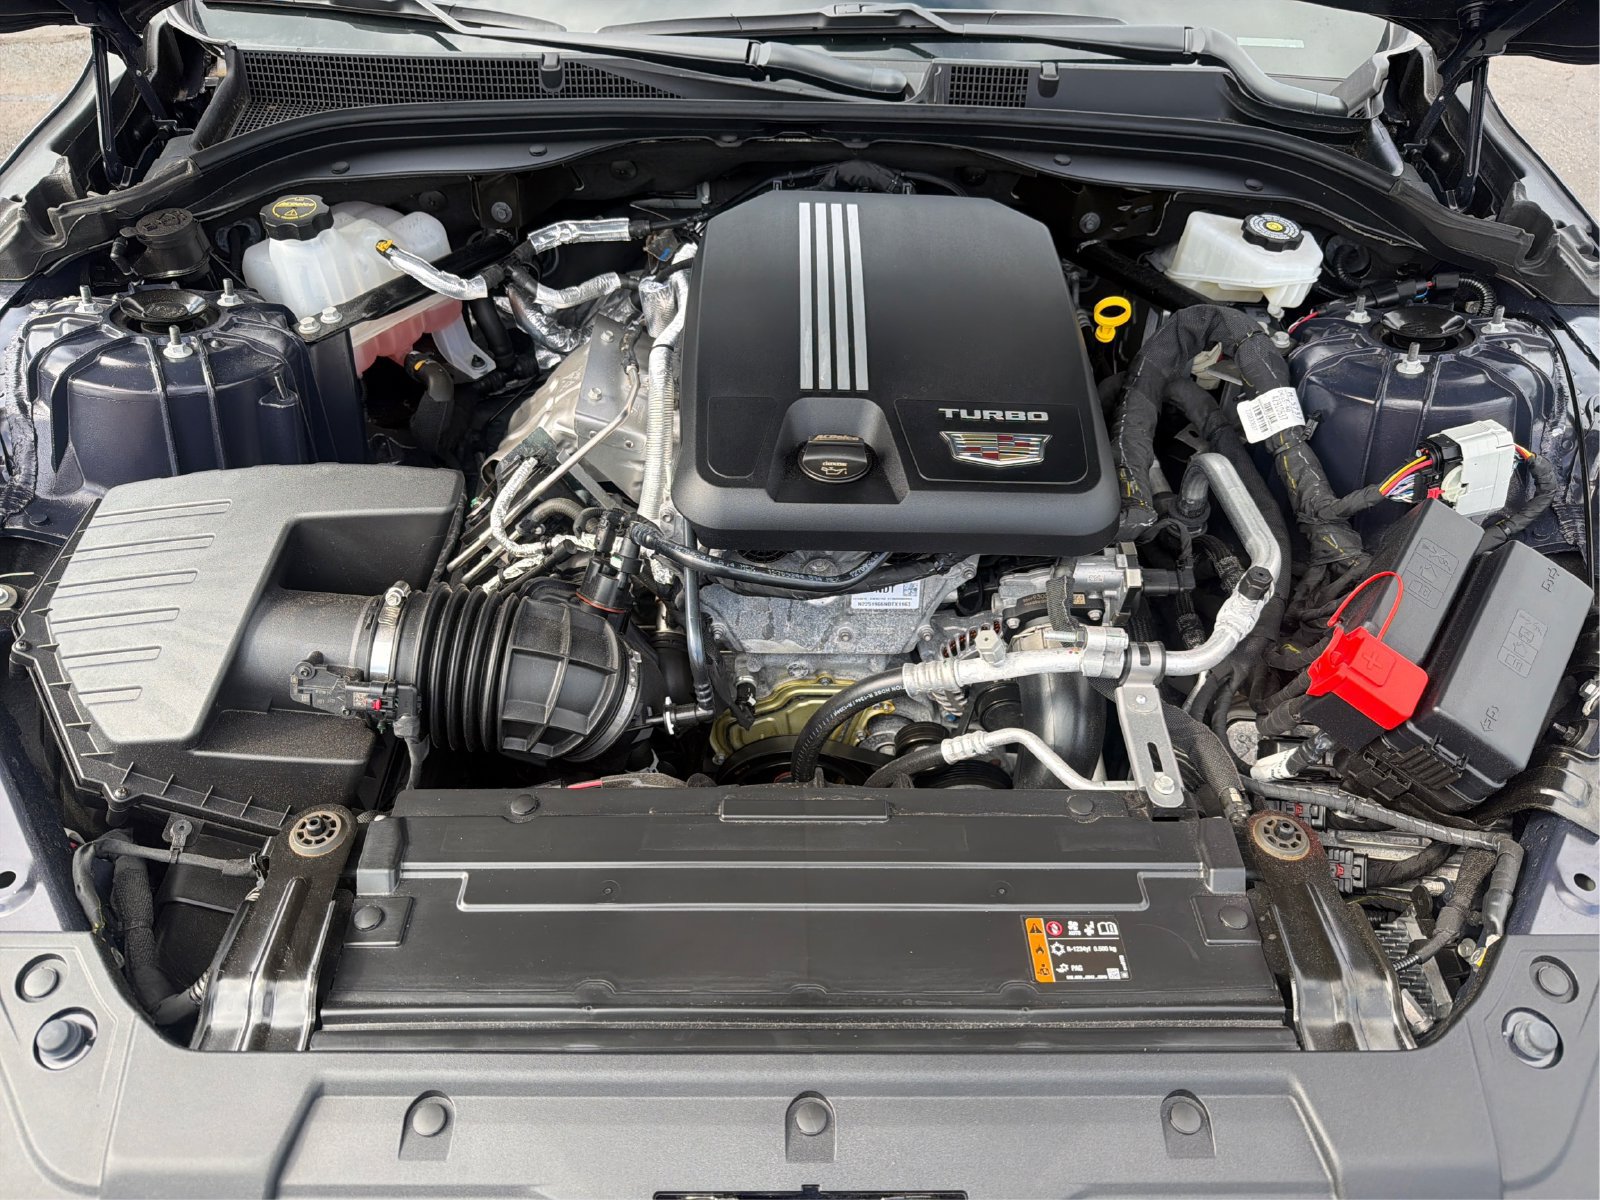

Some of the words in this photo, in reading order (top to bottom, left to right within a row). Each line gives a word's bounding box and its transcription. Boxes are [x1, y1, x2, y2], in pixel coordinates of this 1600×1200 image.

[938, 408, 1049, 421] TURBO
[874, 688, 890, 697] HOSE
[1109, 945, 1117, 953] kg
